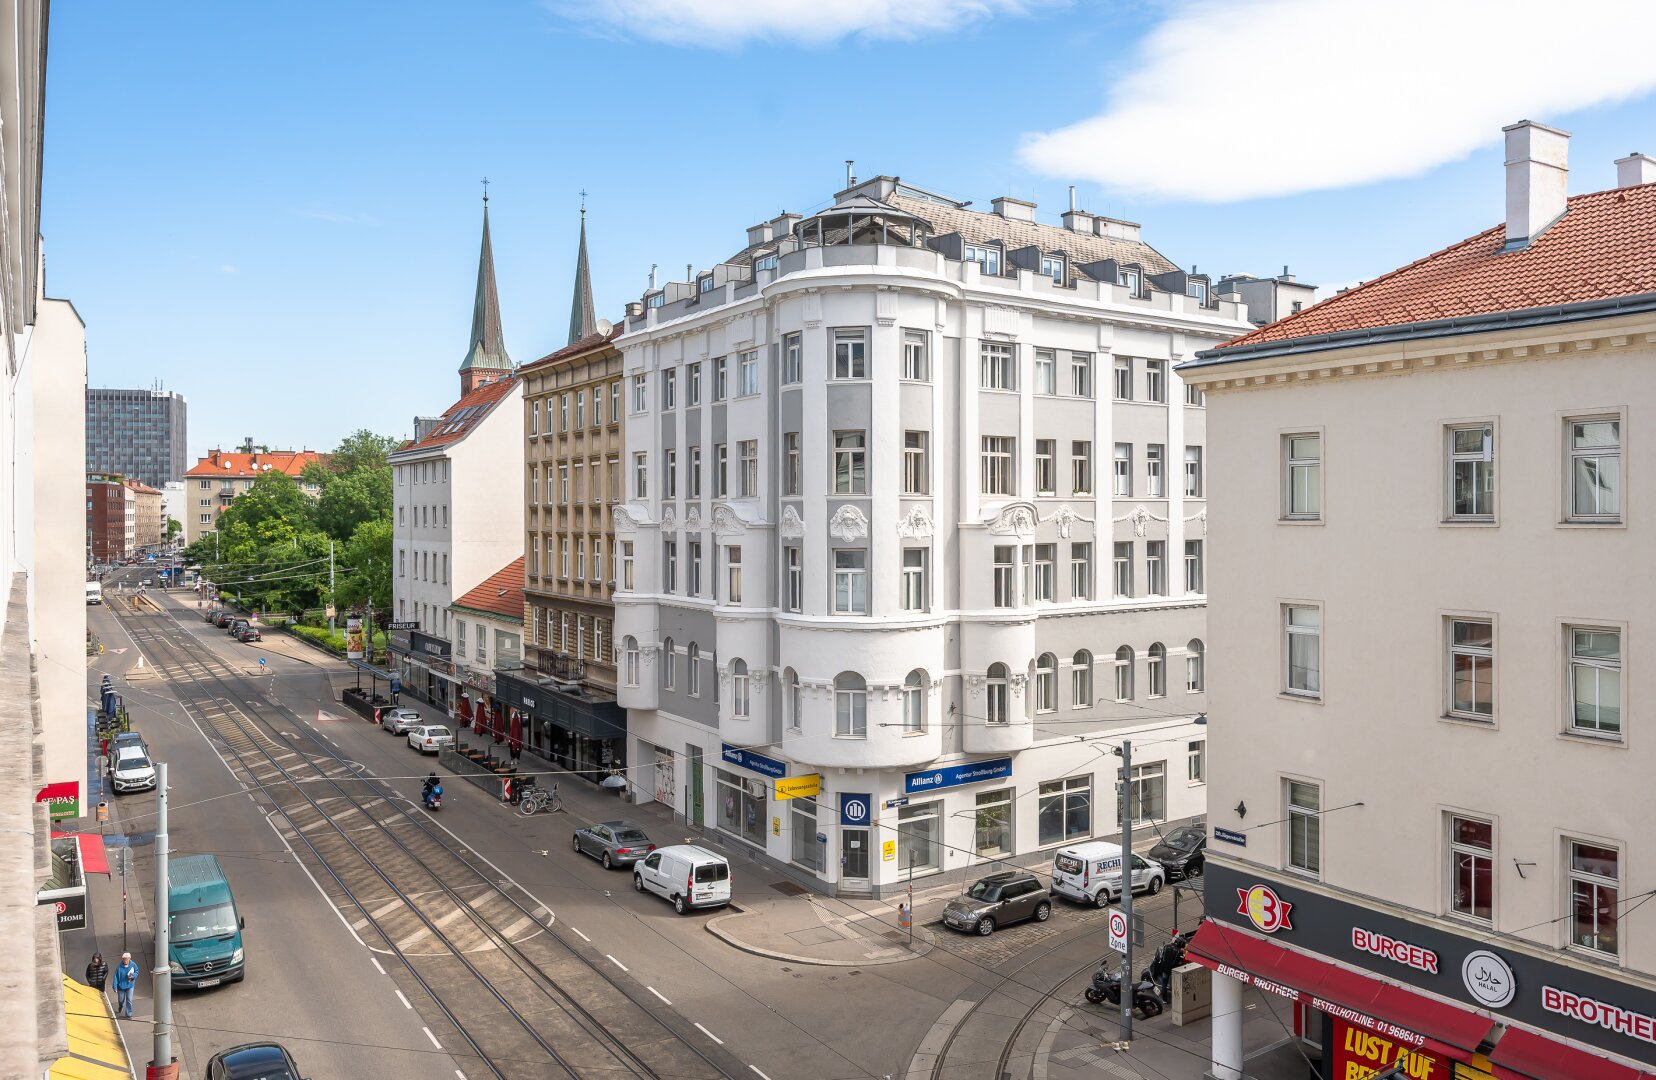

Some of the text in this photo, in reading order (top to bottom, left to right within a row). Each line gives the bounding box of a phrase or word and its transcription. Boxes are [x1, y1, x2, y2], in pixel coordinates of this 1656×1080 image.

[388, 622, 416, 630] FRISEUR
[911, 776, 934, 786] Allianz
[955, 772, 972, 781] Agentur
[60, 914, 84, 923] HOME
[1113, 919, 1123, 933] 30
[1110, 936, 1126, 951] Zone
[1353, 928, 1438, 973] BURGER
[1217, 963, 1299, 1001] BURGER BROTHERS
[1474, 966, 1502, 985] حلال
[1478, 981, 1498, 993] HALAL
[1312, 997, 1426, 1046] BESTELLHOTLINE: 01 9686415
[1543, 987, 1656, 1042] BROTHE
[1344, 1026, 1436, 1080] LUST AUF
